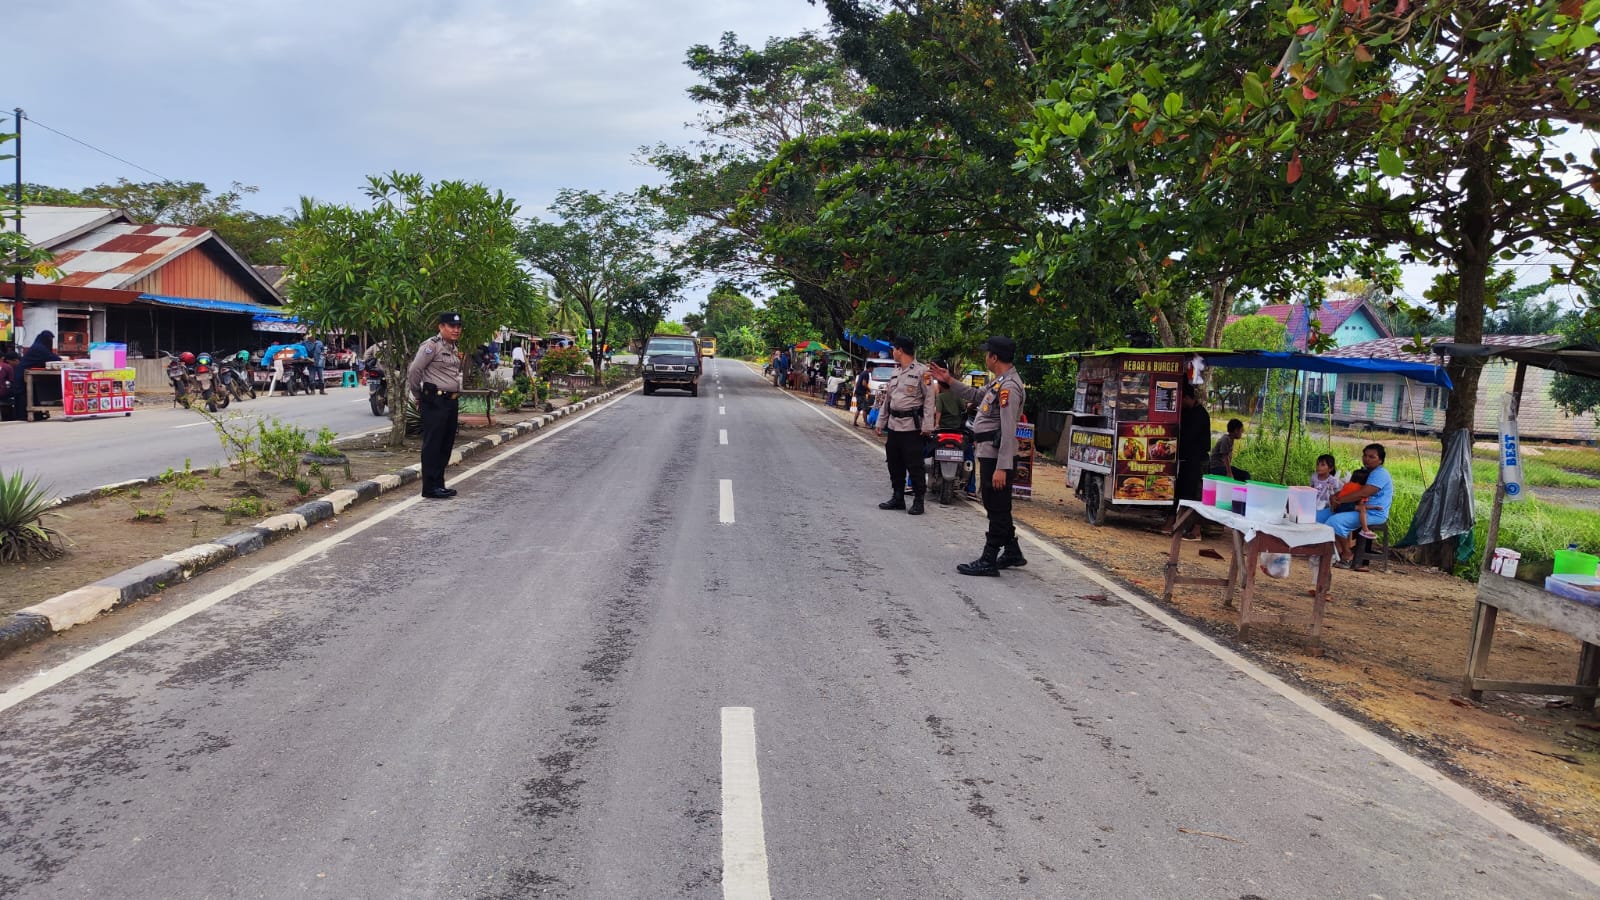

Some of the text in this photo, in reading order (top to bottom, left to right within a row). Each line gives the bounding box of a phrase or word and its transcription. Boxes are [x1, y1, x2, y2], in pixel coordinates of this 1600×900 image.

[1123, 360, 1145, 371] KEBAB
[1153, 361, 1179, 372] BURGER
[1131, 424, 1166, 436] Kebab
[1504, 434, 1517, 466] BEST
[1127, 461, 1166, 474] Burger
